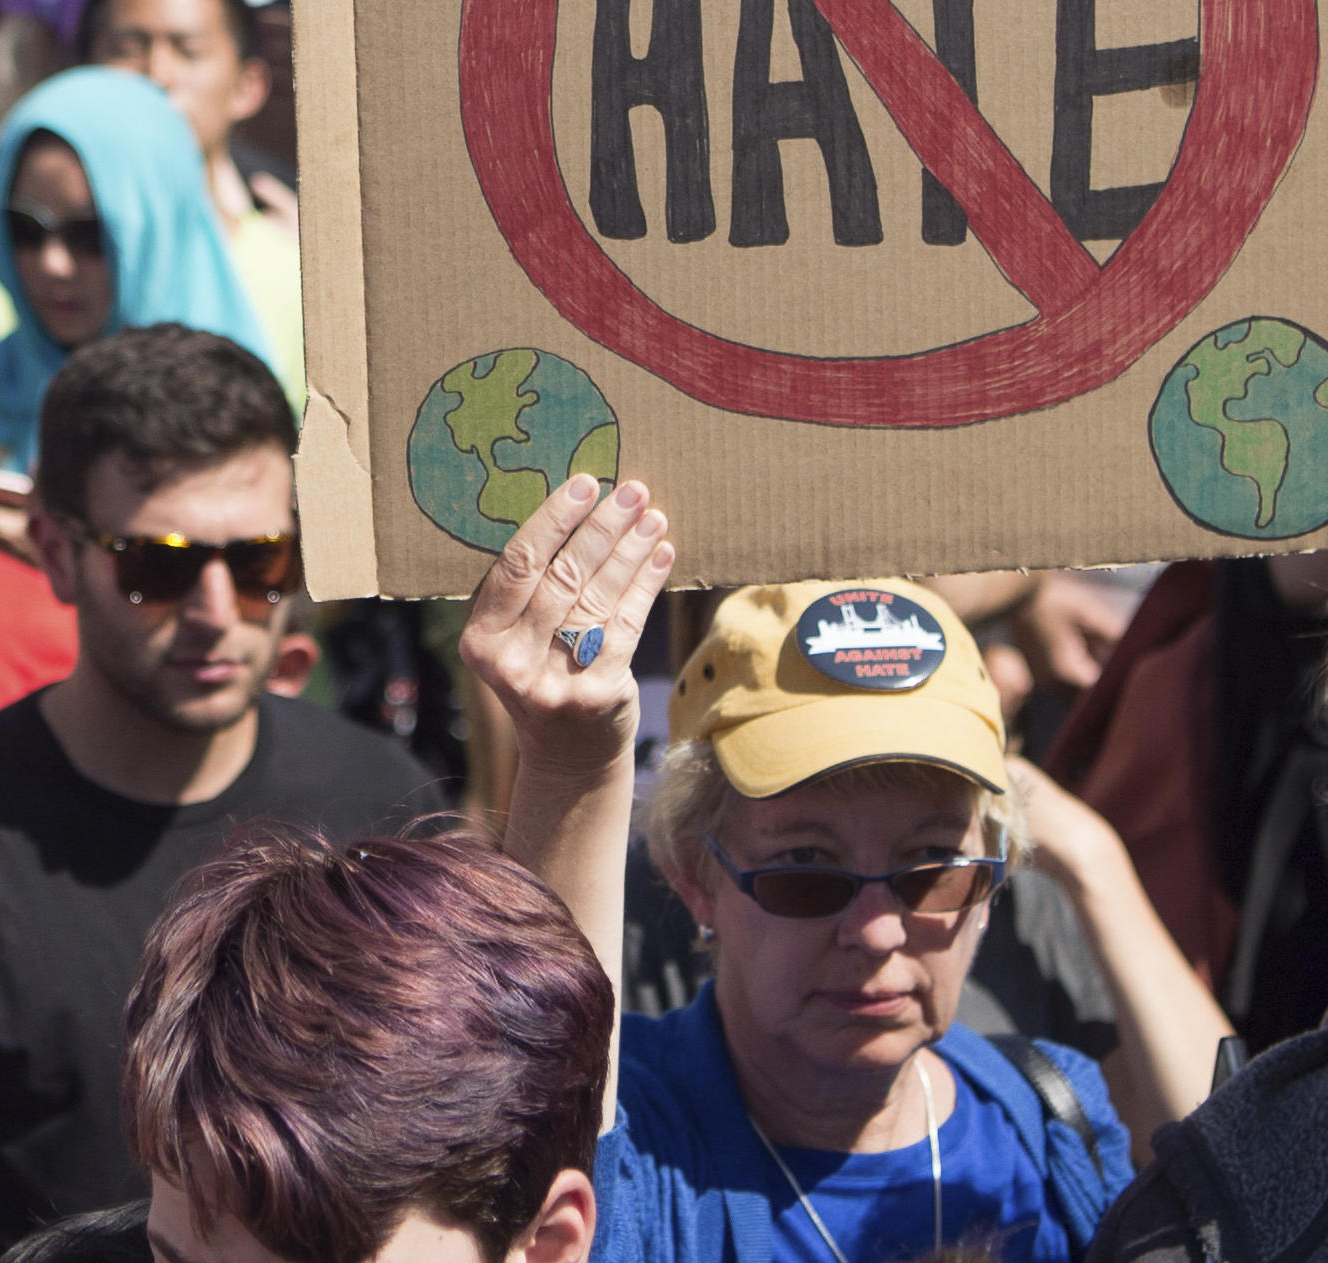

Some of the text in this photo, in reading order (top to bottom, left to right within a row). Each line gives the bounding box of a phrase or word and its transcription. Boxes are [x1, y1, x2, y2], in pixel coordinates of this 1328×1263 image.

[828, 590, 895, 607] UNITE
[833, 647, 924, 664] AGAINST
[855, 662, 911, 679] HATE
